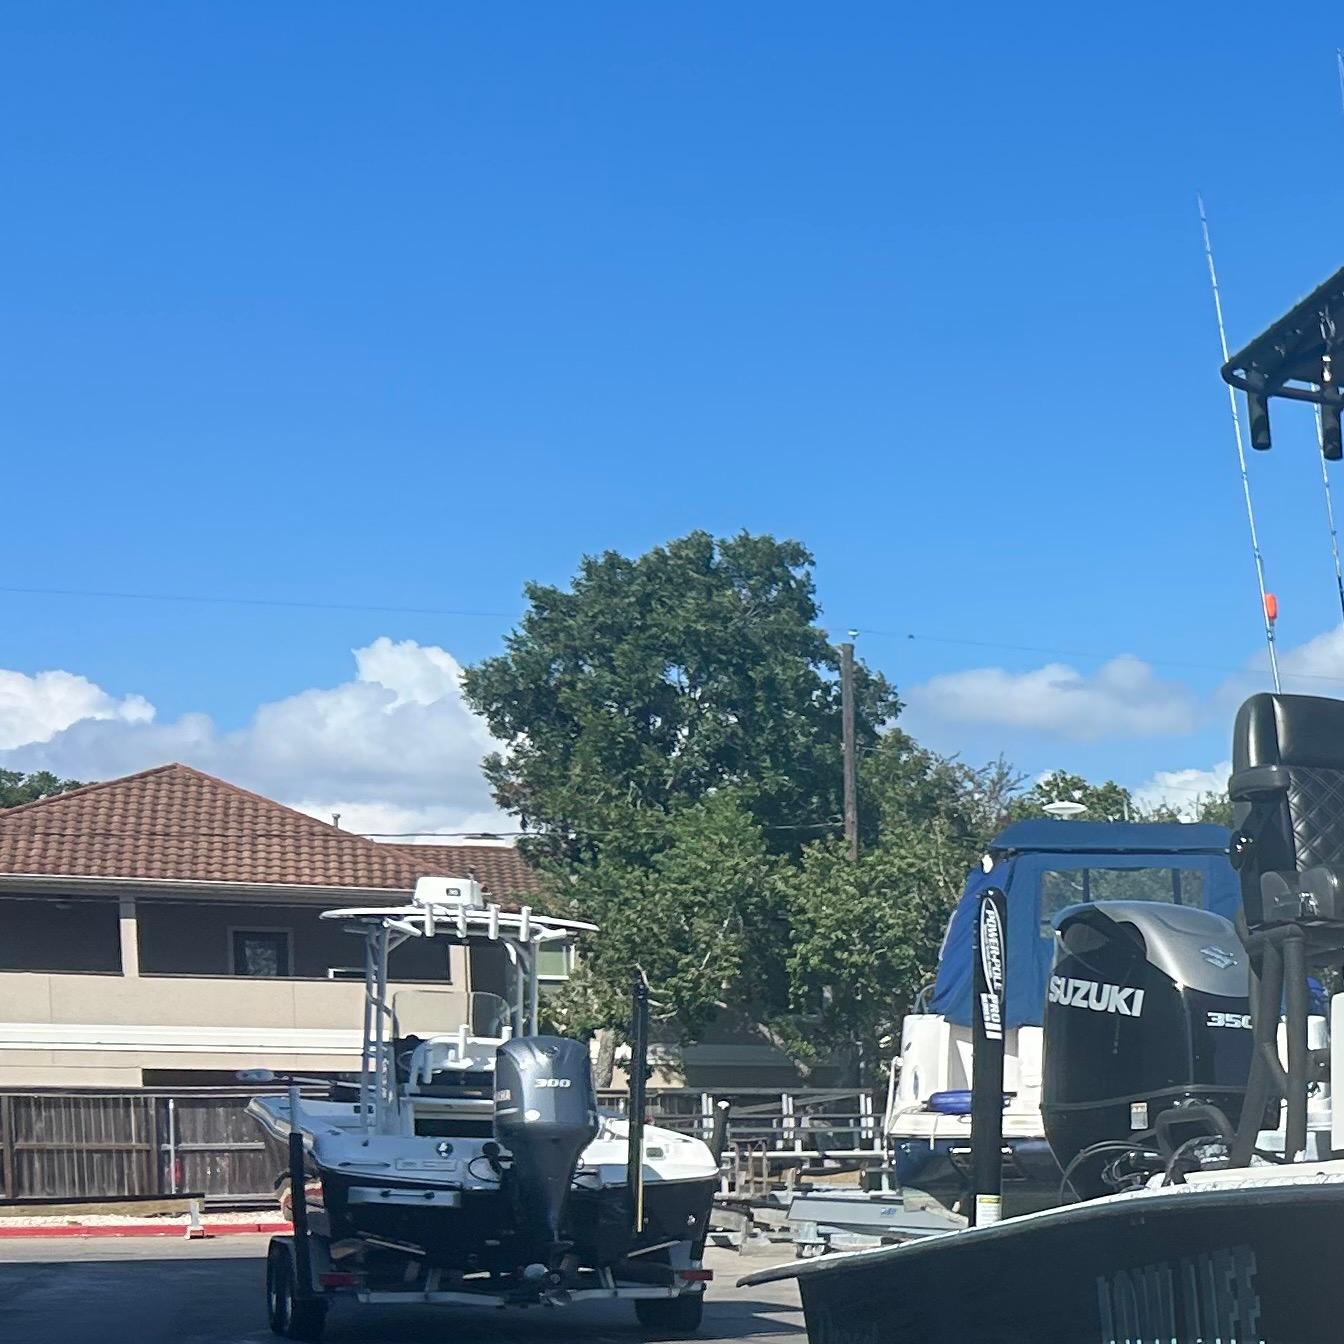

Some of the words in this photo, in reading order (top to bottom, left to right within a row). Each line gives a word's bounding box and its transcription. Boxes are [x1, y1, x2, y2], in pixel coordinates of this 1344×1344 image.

[985, 909, 1003, 991] POWER-POLE
[1048, 975, 1145, 1018] SUZUKI
[534, 1078, 572, 1089] 300
